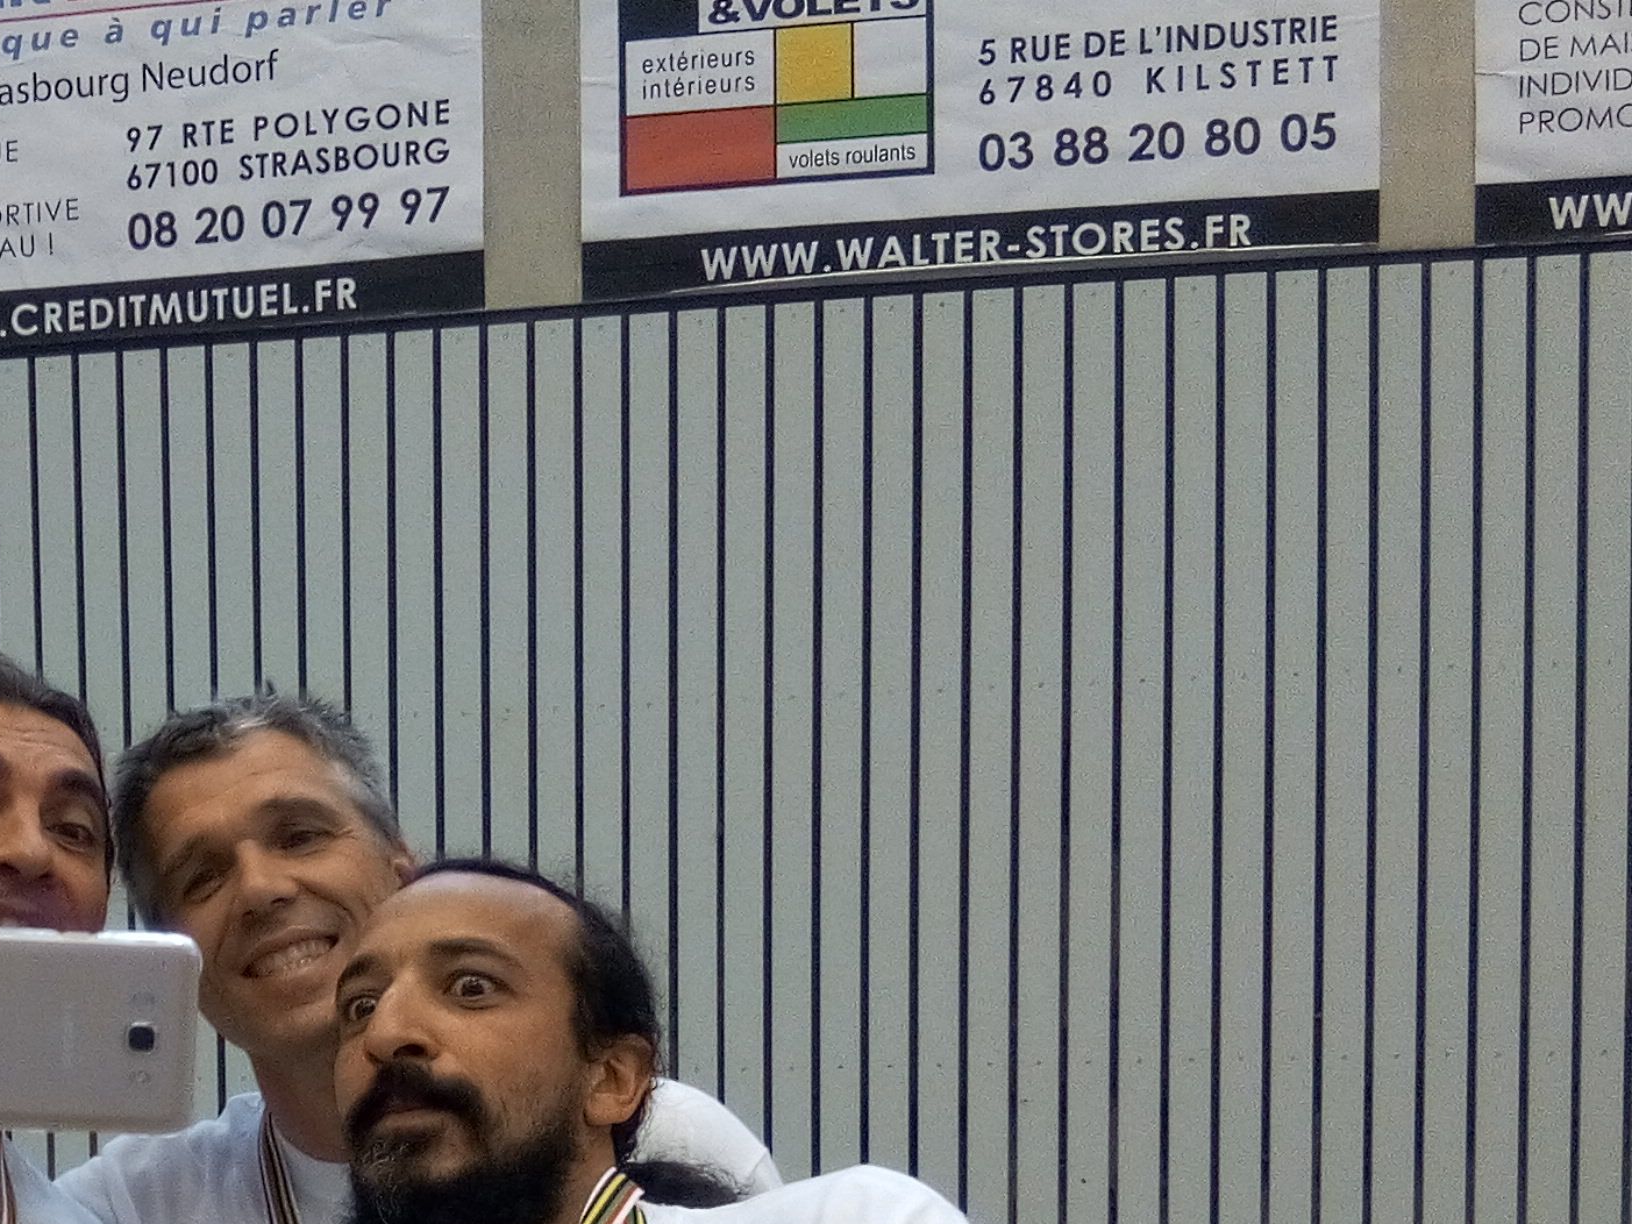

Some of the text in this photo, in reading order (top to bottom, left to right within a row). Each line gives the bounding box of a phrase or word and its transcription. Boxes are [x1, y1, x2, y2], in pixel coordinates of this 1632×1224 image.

[104, 17, 124, 45] à
[150, 8, 221, 46] qui
[244, 0, 392, 38] parler
[1519, 0, 1632, 25] CONST
[642, 48, 755, 74] extérieurs
[977, 15, 1338, 66] 5 RUE DE L'INDUSTRIE
[1520, 31, 1632, 61] DE MAI
[142, 48, 279, 92] Neudorf
[642, 74, 755, 100] intérieurs
[979, 55, 1339, 105] 67840 KILSTETT
[1519, 68, 1632, 99] INDIVID
[126, 99, 450, 152] 97 RTE POLYGONE
[979, 111, 1336, 171] 03 88 20 80 05
[126, 137, 450, 191] 67100 STRASBOURG
[789, 143, 916, 168] volets roulants
[128, 186, 450, 250] 08 20 07 99 97
[48, 232, 54, 255] !
[700, 214, 1253, 281] WWW.WALTER-STORES.FR
